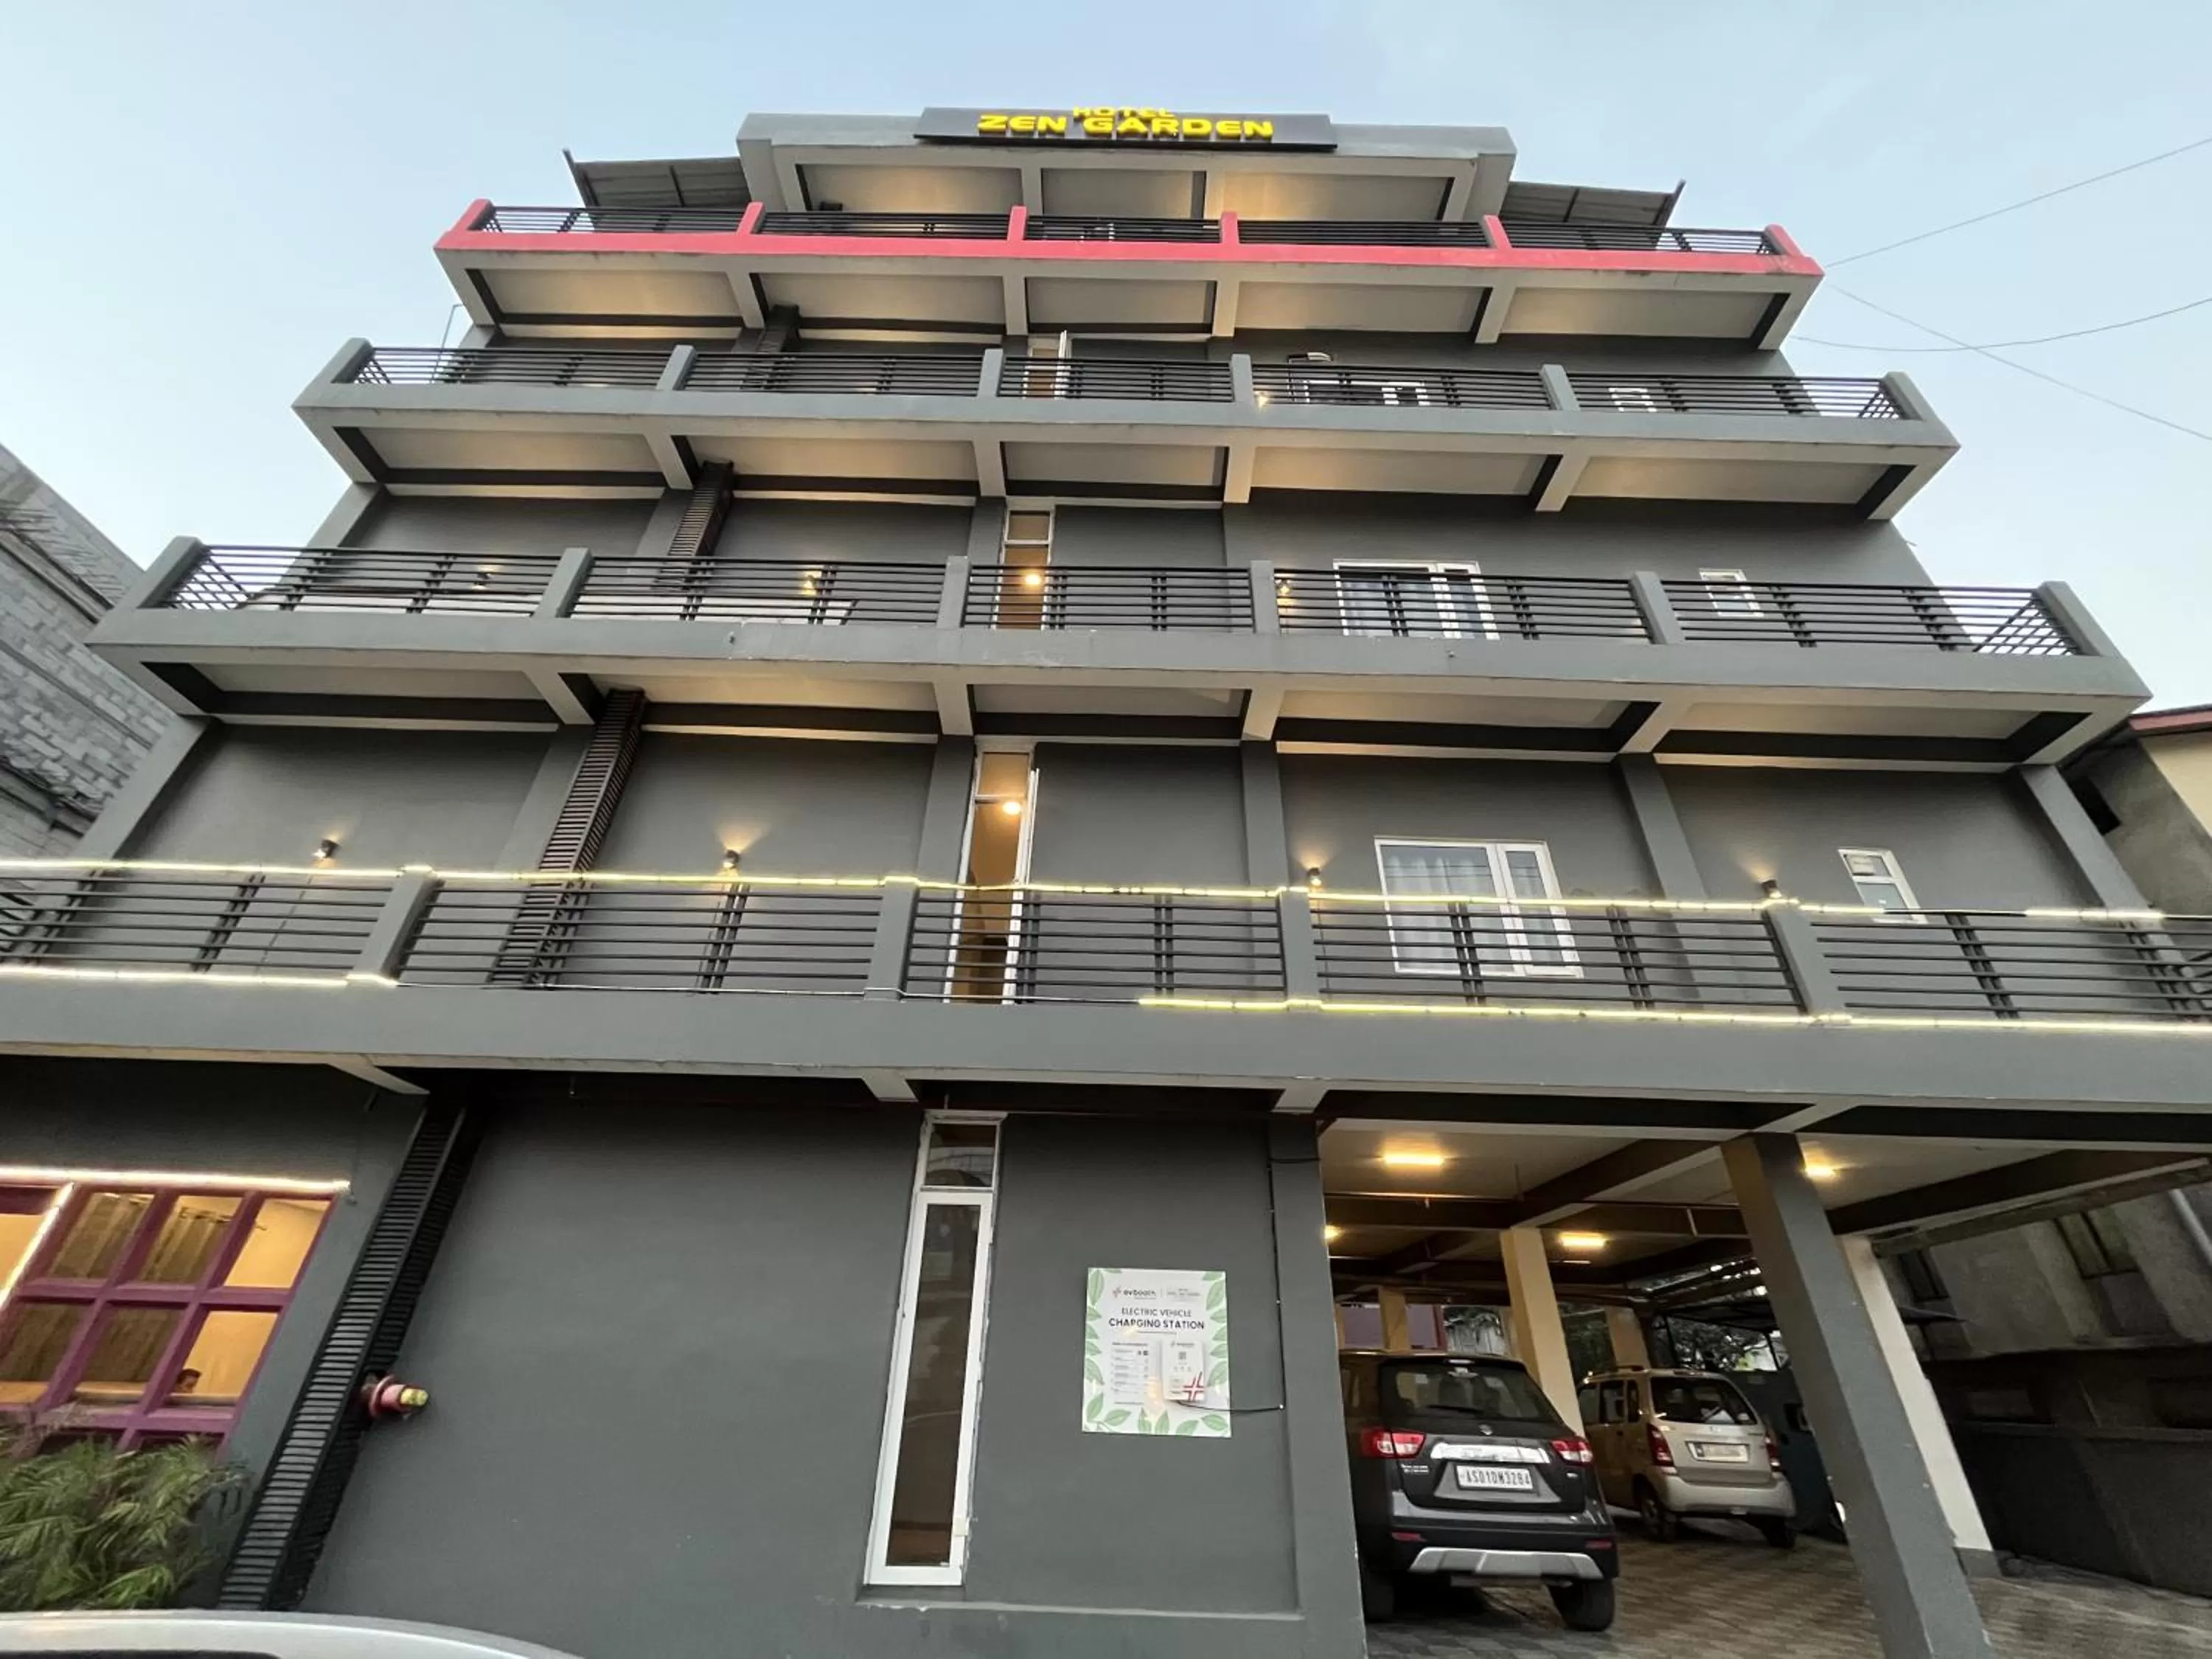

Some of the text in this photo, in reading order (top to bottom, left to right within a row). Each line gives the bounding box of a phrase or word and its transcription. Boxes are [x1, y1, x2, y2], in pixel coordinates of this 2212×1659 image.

[1073, 106, 1175, 117] HOTEL
[977, 114, 1274, 137] ZEN GARDEN
[1121, 1306, 1192, 1318] ELECTRIC VEHICLE
[1108, 1317, 1204, 1330] CHARGING STATION
